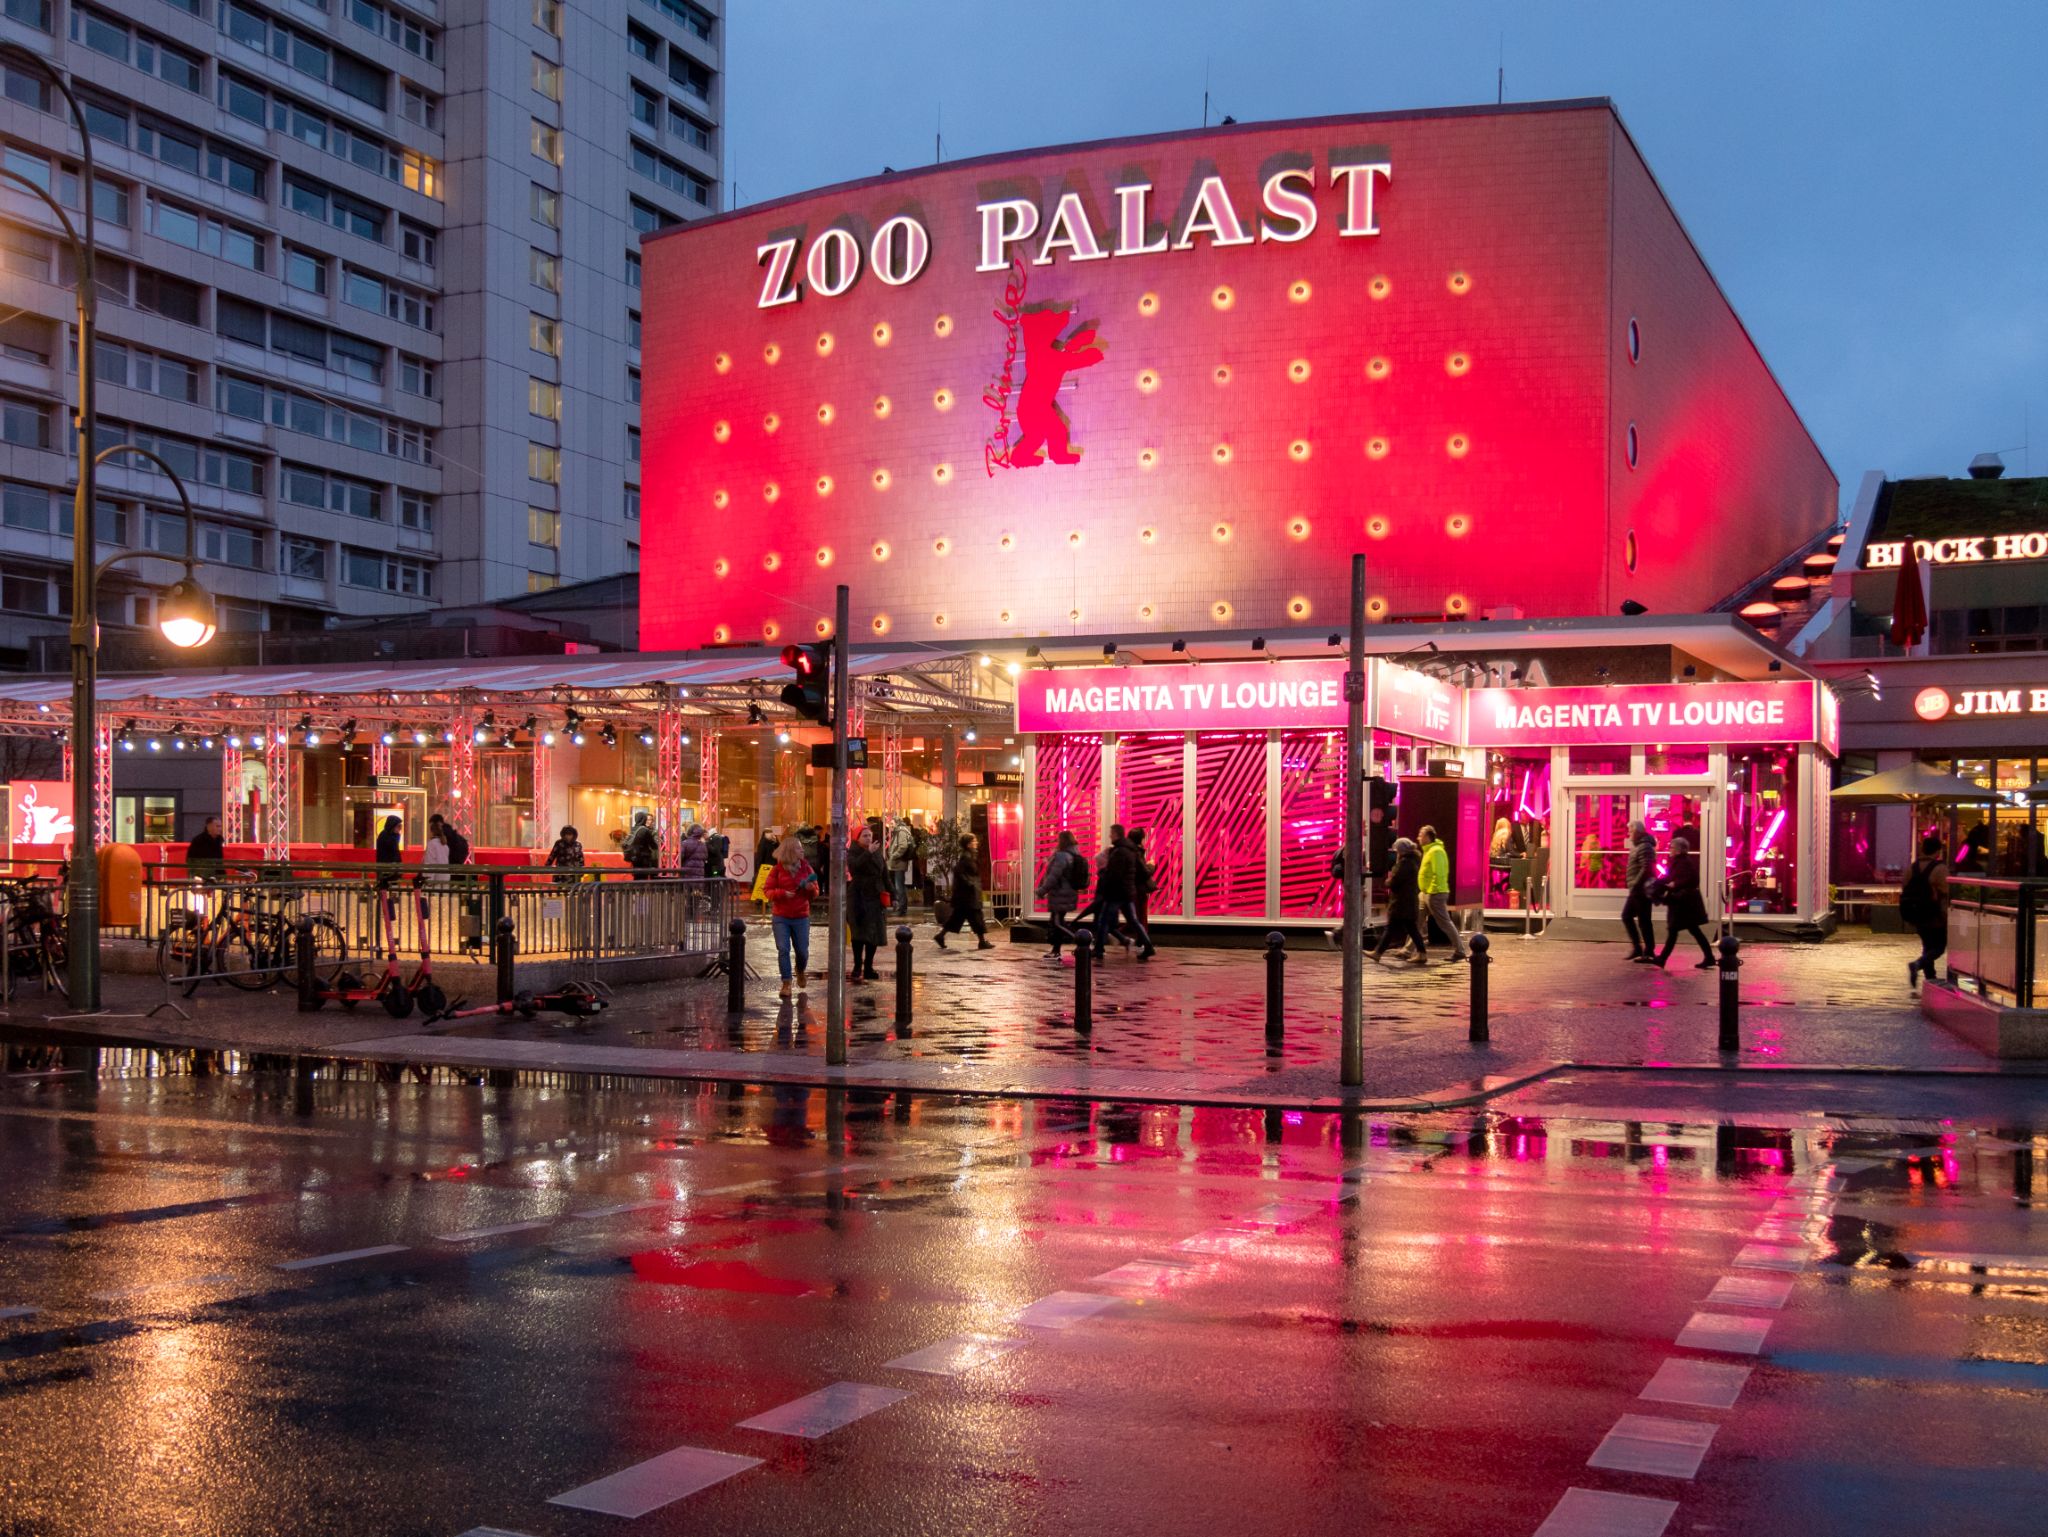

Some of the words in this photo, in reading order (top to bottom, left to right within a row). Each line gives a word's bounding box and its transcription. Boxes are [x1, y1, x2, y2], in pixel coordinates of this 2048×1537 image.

[756, 215, 932, 310] ZOO
[974, 162, 1392, 272] PALAST
[982, 258, 1027, 478] Berlinale
[1993, 531, 2048, 560] HO
[1045, 684, 1175, 713] MAGENTA
[1179, 683, 1215, 710] TV
[1220, 680, 1339, 709] LOUNGE
[1954, 690, 2022, 715] JIM
[2029, 689, 2048, 712] B
[1495, 703, 1622, 729] MAGENTA
[1627, 703, 1662, 727] TV
[1668, 700, 1784, 726] LOUNGE
